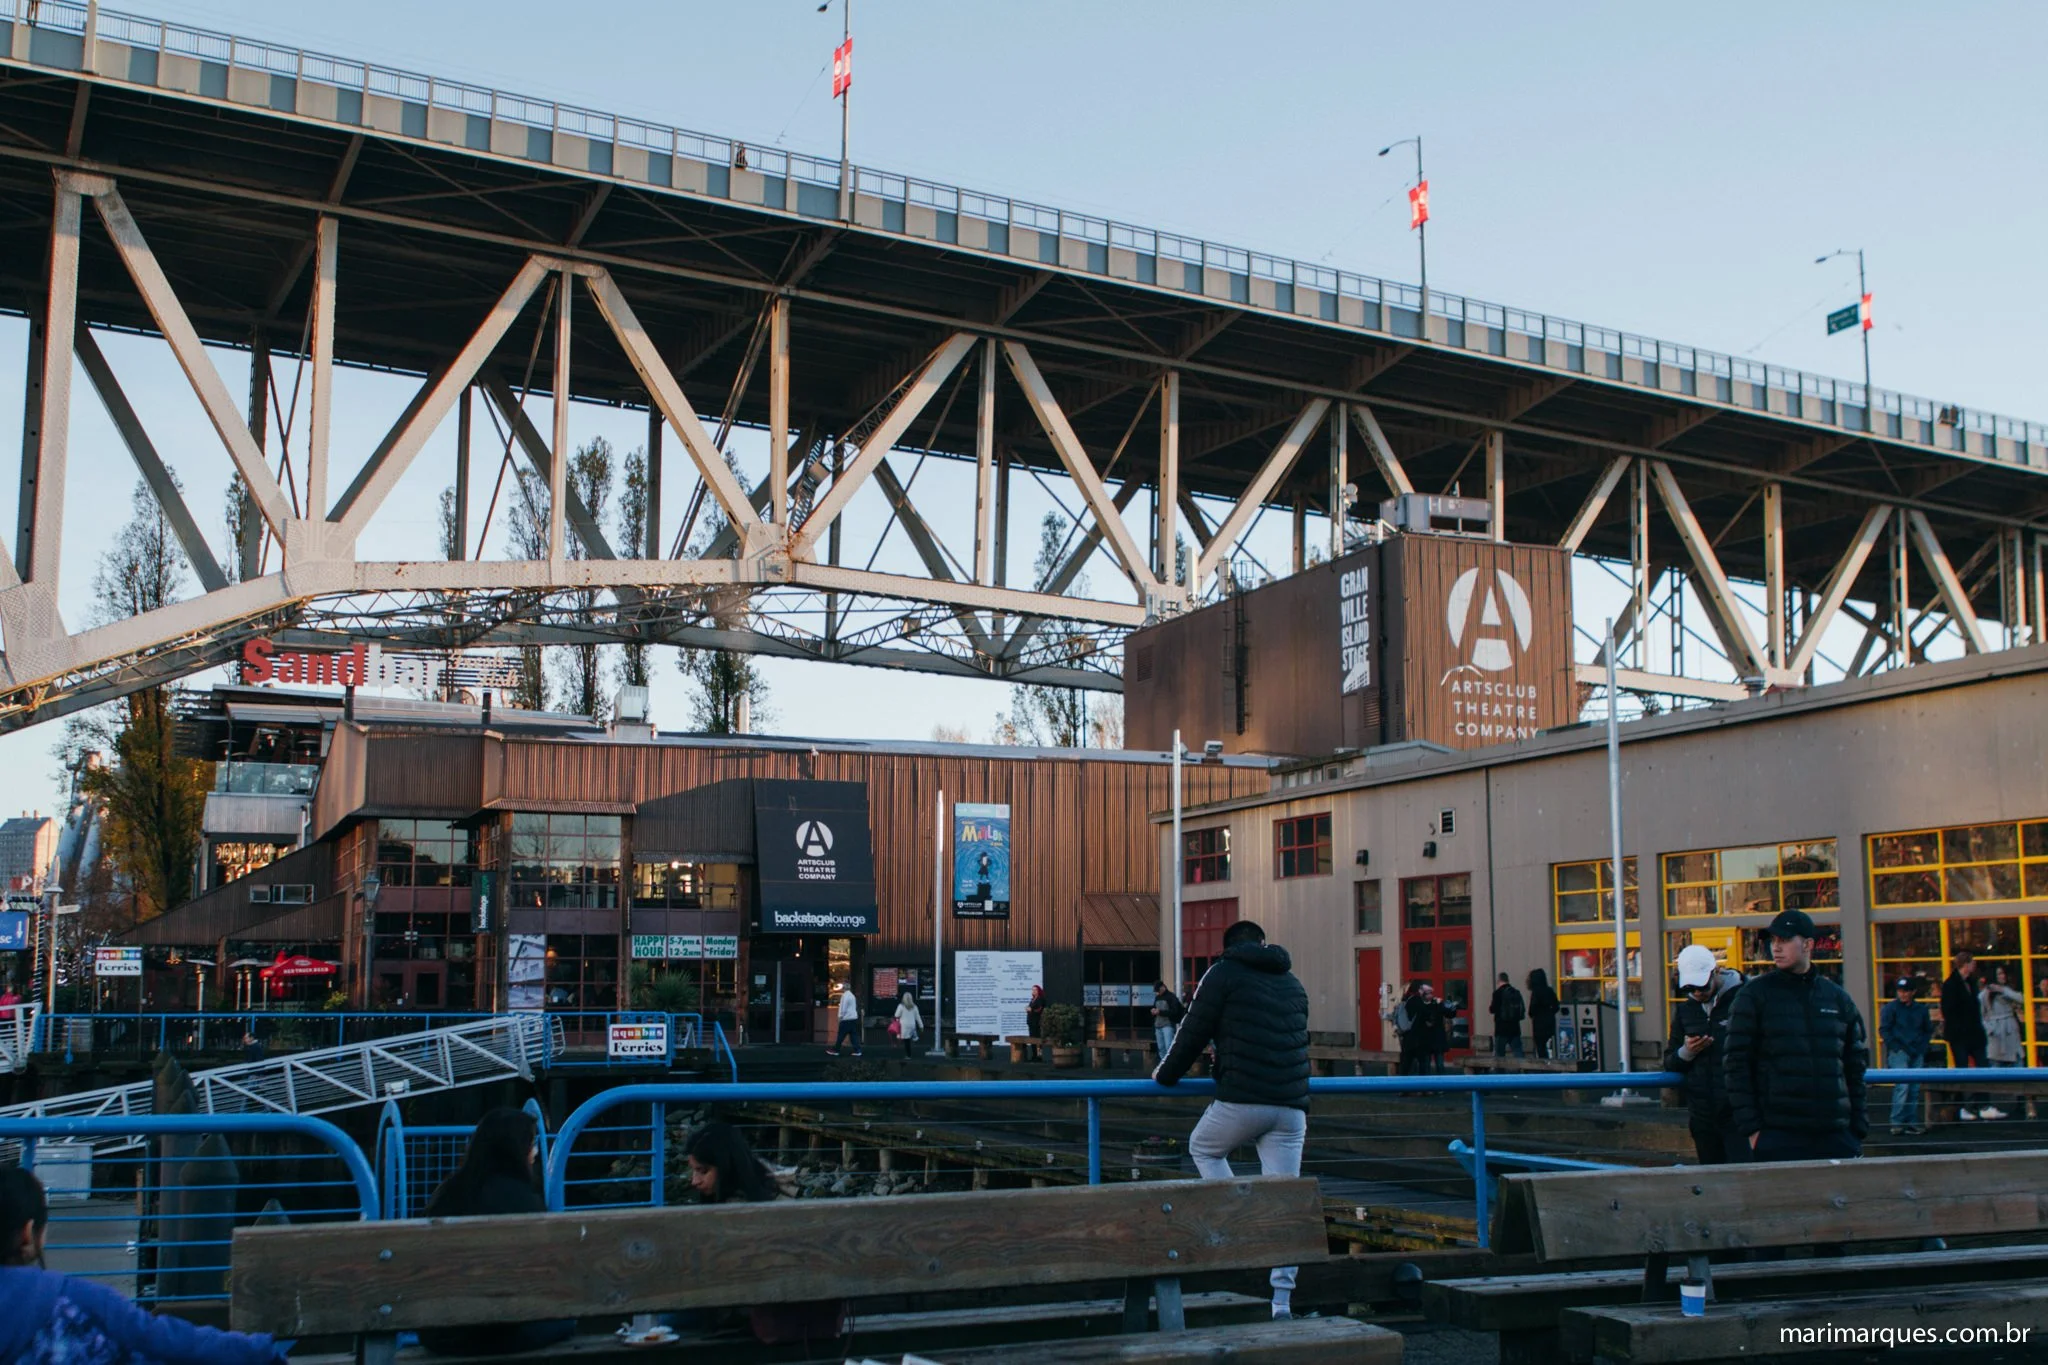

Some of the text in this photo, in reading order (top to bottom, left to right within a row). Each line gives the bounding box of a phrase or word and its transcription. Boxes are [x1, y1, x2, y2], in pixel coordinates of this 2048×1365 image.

[1341, 566, 1368, 598] GRAN
[1341, 594, 1368, 626] VILLE
[1342, 620, 1369, 649] ISLAND
[243, 637, 444, 689] Sandbar
[1342, 642, 1370, 672] STAGE
[1451, 680, 1537, 699] ARTSCLUB
[1453, 700, 1537, 720] THEATRE
[1455, 721, 1539, 739] COMPANY
[634, 935, 666, 946] HAPPY
[668, 936, 695, 946] 5-7pm
[705, 937, 737, 948] Monday
[635, 946, 664, 957] HOUR
[709, 946, 736, 957] Friday
[98, 962, 140, 971] Ferries
[612, 1028, 663, 1039] aquabus
[613, 1041, 663, 1052] Ferries
